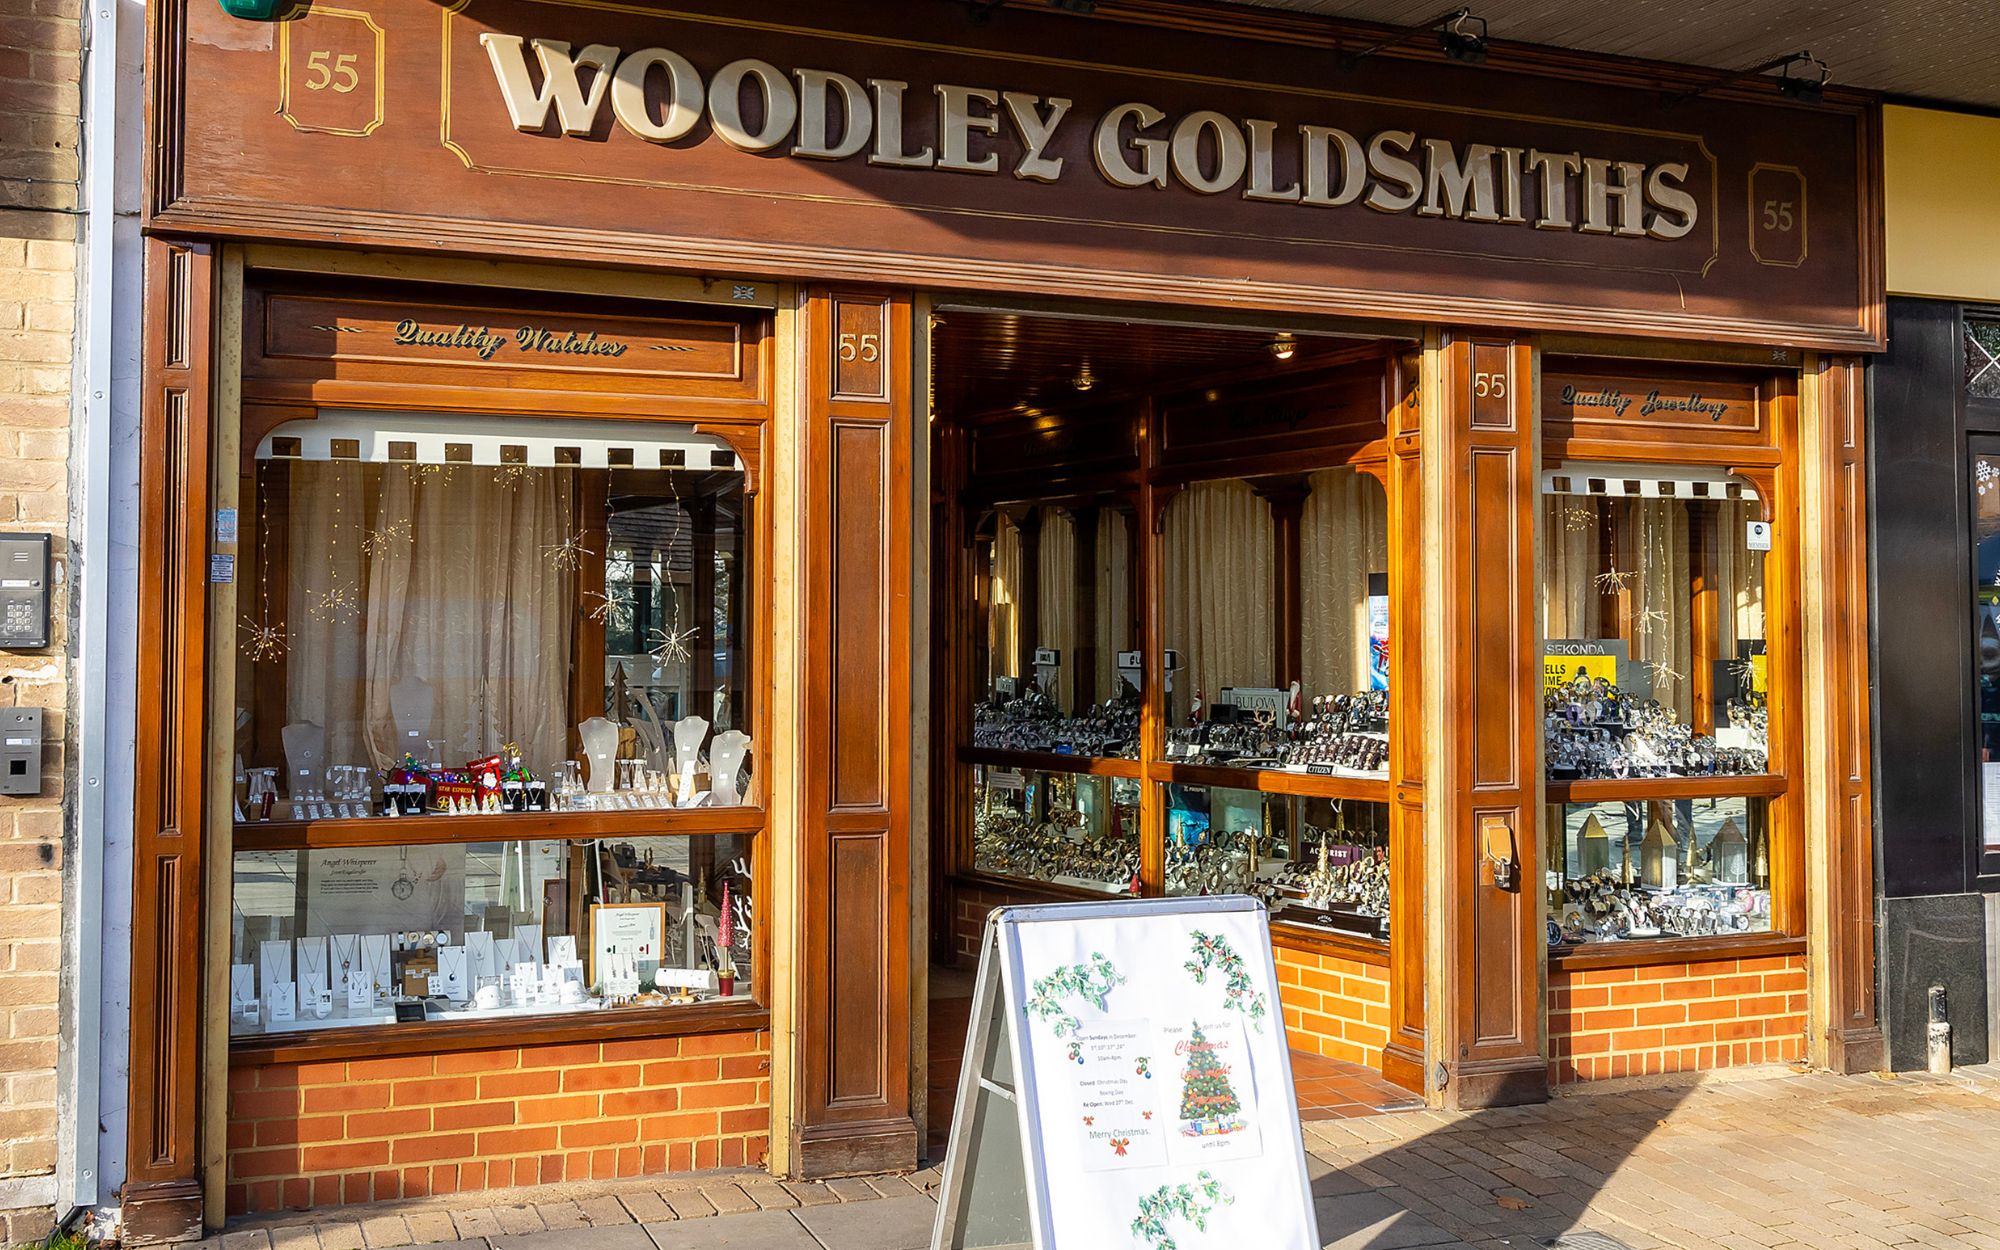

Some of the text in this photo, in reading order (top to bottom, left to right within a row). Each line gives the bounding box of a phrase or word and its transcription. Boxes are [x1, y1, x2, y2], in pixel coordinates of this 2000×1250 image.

[304, 50, 360, 94] 55
[479, 32, 1699, 242] WOODLEY GOLDSMITHS
[1762, 200, 1794, 233] 55
[393, 317, 630, 360] Quality Watches
[838, 332, 880, 364] 55
[1474, 372, 1507, 400] 55
[1560, 383, 1729, 422] Quality Jewellery
[1546, 644, 1605, 655] SEKONDA
[1545, 664, 1566, 675] ELLS
[1544, 676, 1562, 686] IME
[1235, 696, 1276, 709] BULOVA
[1307, 765, 1332, 775] CITIZEN
[1309, 847, 1348, 858] ACRIST
[1163, 1026, 1183, 1034] Please
[1089, 1130, 1111, 1139] Merry
